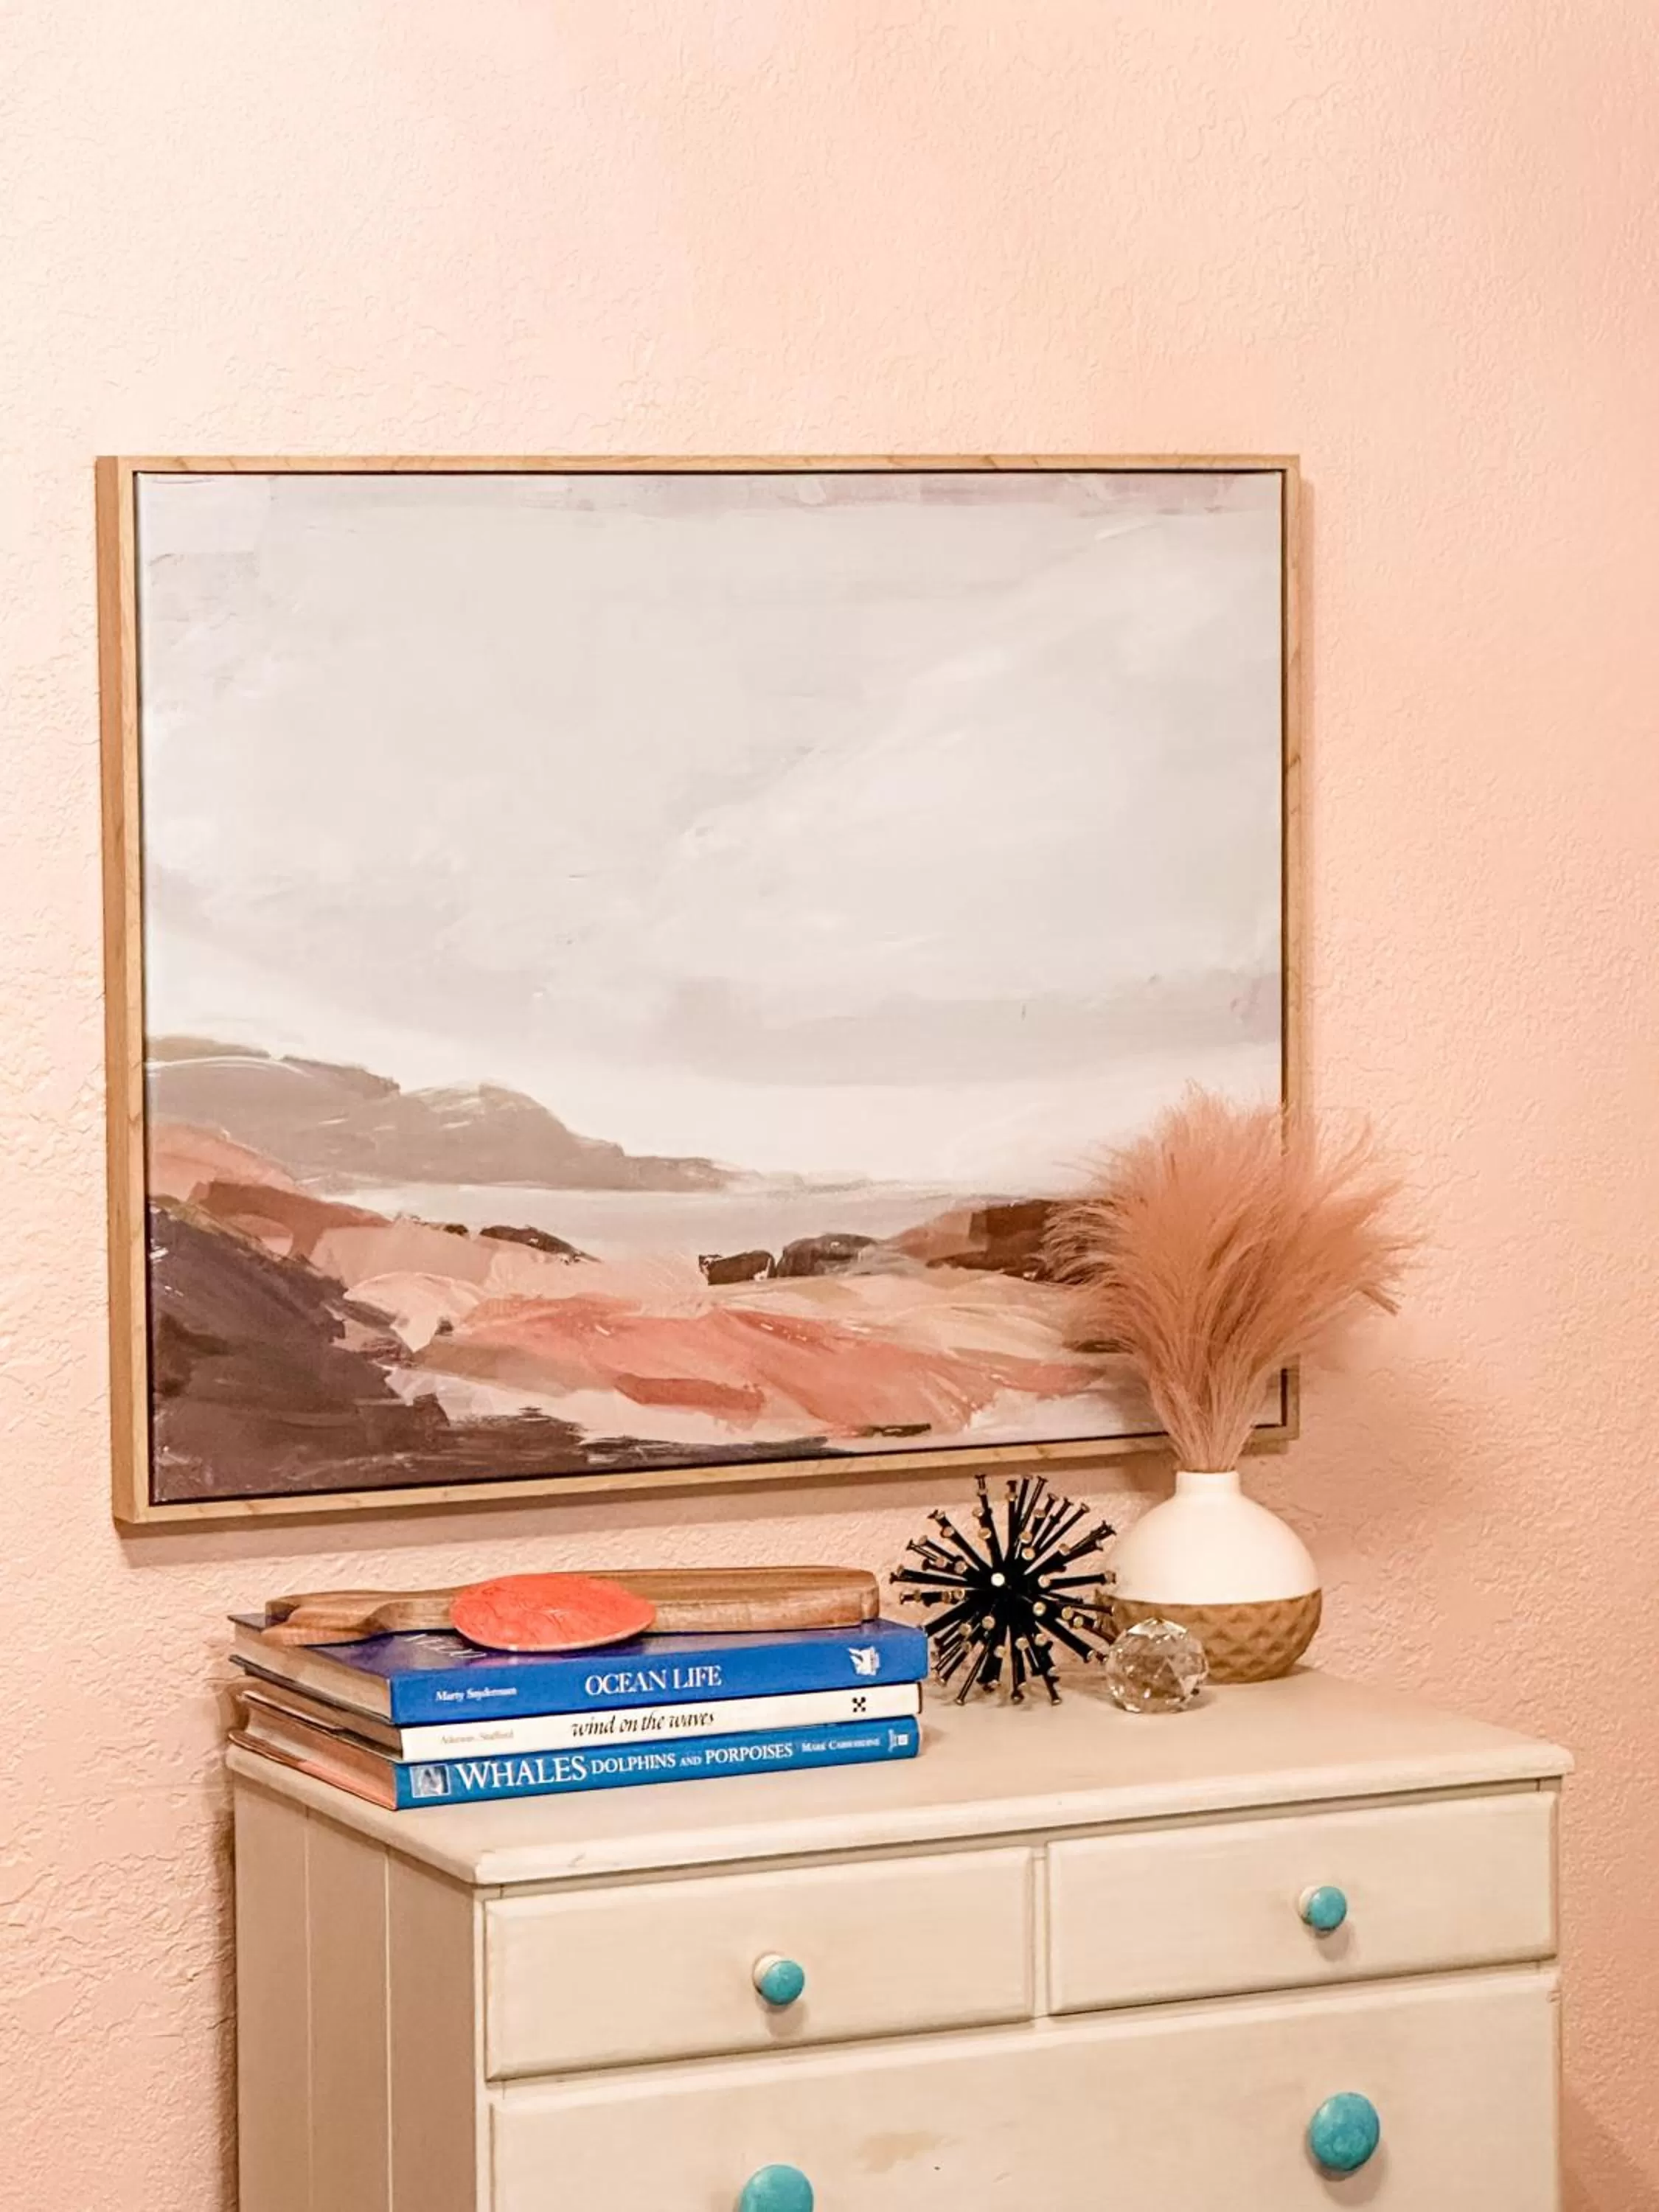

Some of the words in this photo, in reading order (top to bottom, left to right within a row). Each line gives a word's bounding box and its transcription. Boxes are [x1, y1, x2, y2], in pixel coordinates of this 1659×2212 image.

[585, 1669, 667, 1695] OCEAN
[673, 1665, 723, 1689] LIFE
[571, 1715, 616, 1737] wind
[619, 1717, 638, 1733] on
[641, 1710, 665, 1731] the
[669, 1711, 714, 1728] waves
[455, 1756, 588, 1790] WHALES
[591, 1753, 676, 1774] DOLPHINS
[680, 1756, 701, 1767] AND
[705, 1743, 793, 1764] PORPOISES
